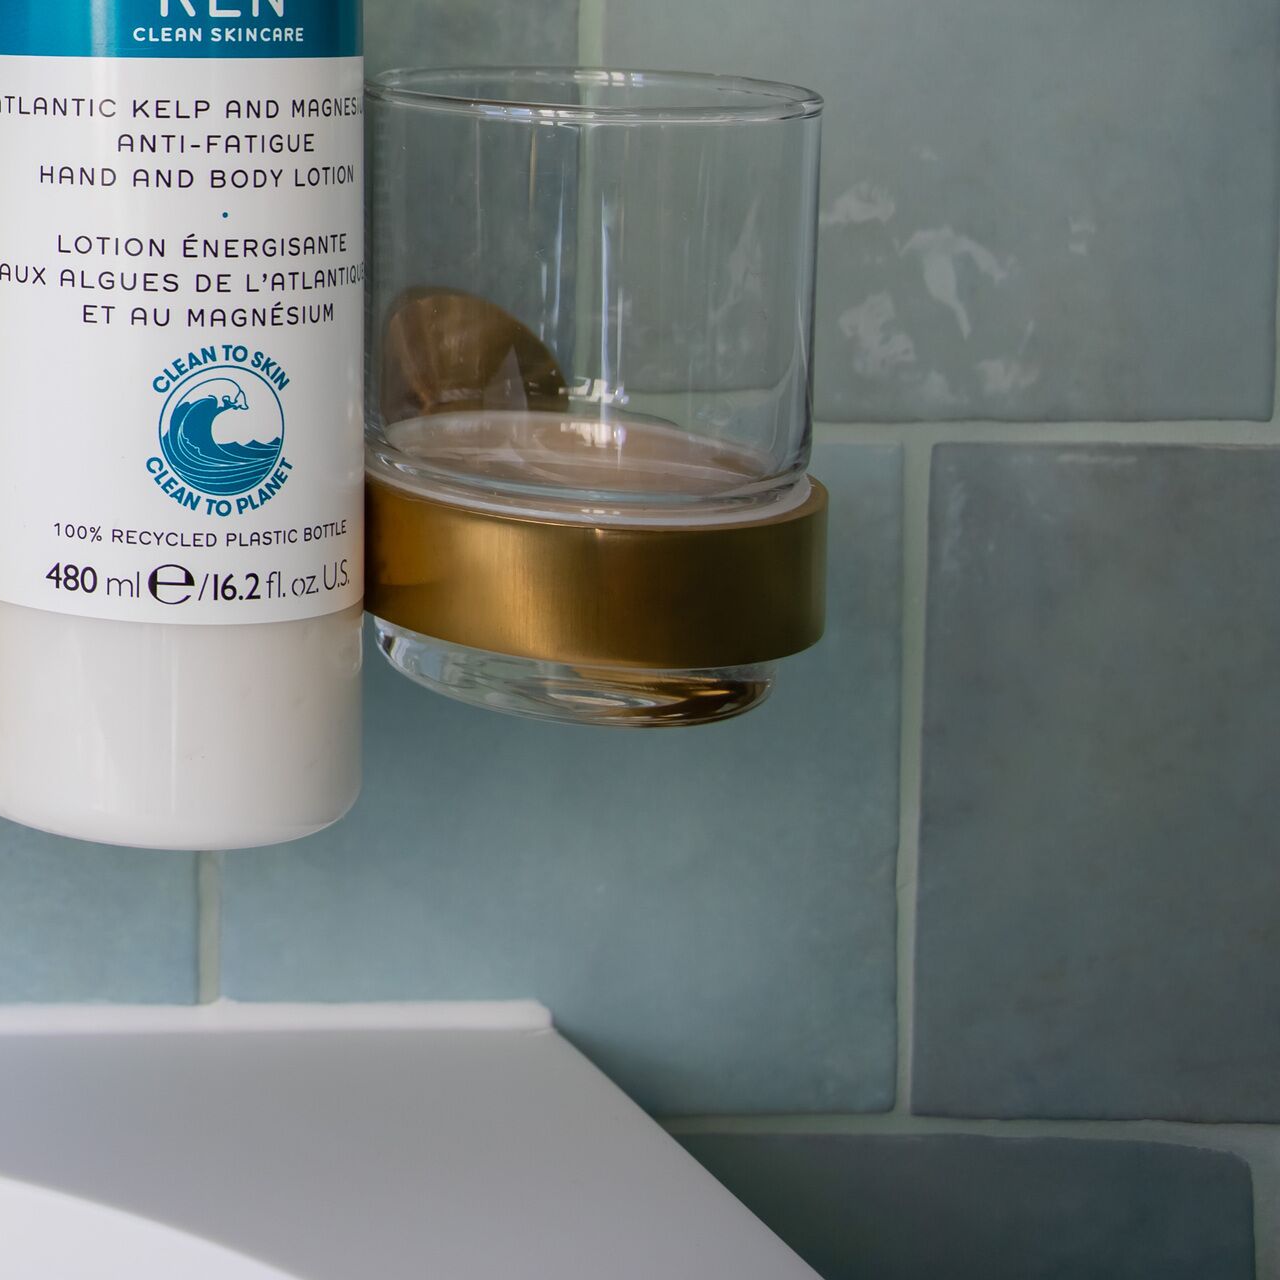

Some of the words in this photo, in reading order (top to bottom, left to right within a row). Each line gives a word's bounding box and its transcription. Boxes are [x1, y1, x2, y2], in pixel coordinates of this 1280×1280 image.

[133, 27, 201, 42] CLEAN
[211, 28, 303, 42] SKINCARE
[133, 100, 210, 119] KELP
[226, 100, 279, 119] AND
[292, 97, 363, 118] MAGNES
[118, 134, 314, 153] ANTI-FATIGUE
[40, 165, 116, 186] HAND
[133, 169, 194, 188] AND
[211, 169, 283, 188] BODY
[295, 165, 353, 187] LOTION
[58, 235, 165, 257] LOTION
[183, 233, 346, 258] ÉNERGISANTE
[0, 263, 46, 285] AUX
[60, 269, 179, 292] ALGUES
[196, 274, 231, 292] DE
[83, 305, 115, 324] ET
[131, 307, 170, 327] AU
[188, 301, 333, 327] MAGNÉSIUM
[152, 344, 217, 394] CLEAN
[221, 344, 249, 364] TO
[250, 350, 290, 392] SKIN
[145, 455, 200, 512] CLEAN
[205, 498, 233, 518] TO
[235, 455, 294, 515] PLANET
[54, 523, 102, 543] 100%
[112, 529, 217, 547] RECYCLED
[226, 529, 297, 547] PLASTIC
[304, 520, 346, 541] BOTTLE
[46, 562, 97, 593] 480
[107, 571, 140, 598] ml
[266, 571, 286, 598] fl.
[292, 575, 319, 596] oz.
[324, 559, 349, 590] U.S.
